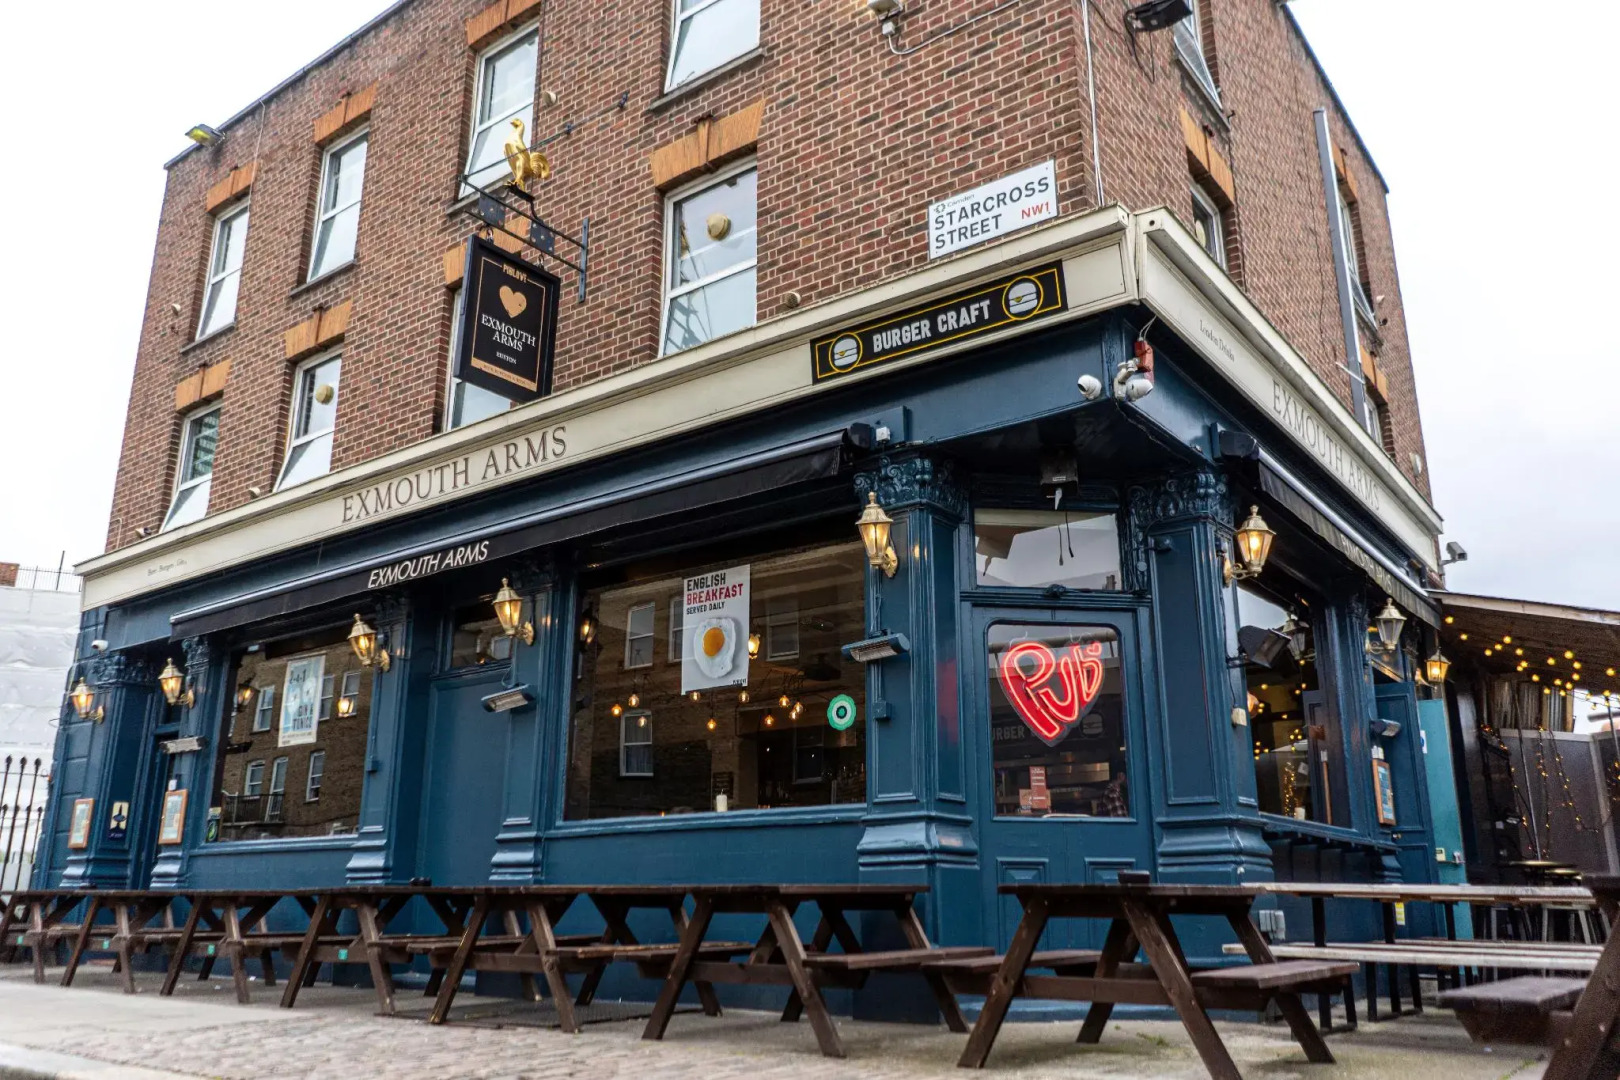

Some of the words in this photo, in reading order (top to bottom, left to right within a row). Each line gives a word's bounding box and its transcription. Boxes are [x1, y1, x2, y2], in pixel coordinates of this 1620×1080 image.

[934, 176, 1050, 231] STARCROSS
[934, 213, 1003, 250] STREET
[1020, 201, 1050, 220] NW1
[481, 313, 536, 347] EXMOUTH
[492, 332, 523, 352] ARMS
[872, 320, 932, 354] BURGER
[936, 299, 991, 334] CRAFT
[1272, 379, 1344, 478] EXMOUTH
[1348, 459, 1380, 511] ARMS
[341, 457, 470, 524] EXMOUTH
[481, 425, 567, 481] ARMS
[367, 552, 442, 589] EXMOUTH
[442, 540, 490, 569] ARMS
[686, 572, 727, 592] ENGLISH
[686, 583, 744, 606] BREAKFAST
[686, 604, 708, 615] SERVED
[708, 601, 726, 611] DAILY
[992, 724, 1025, 741] URGER
